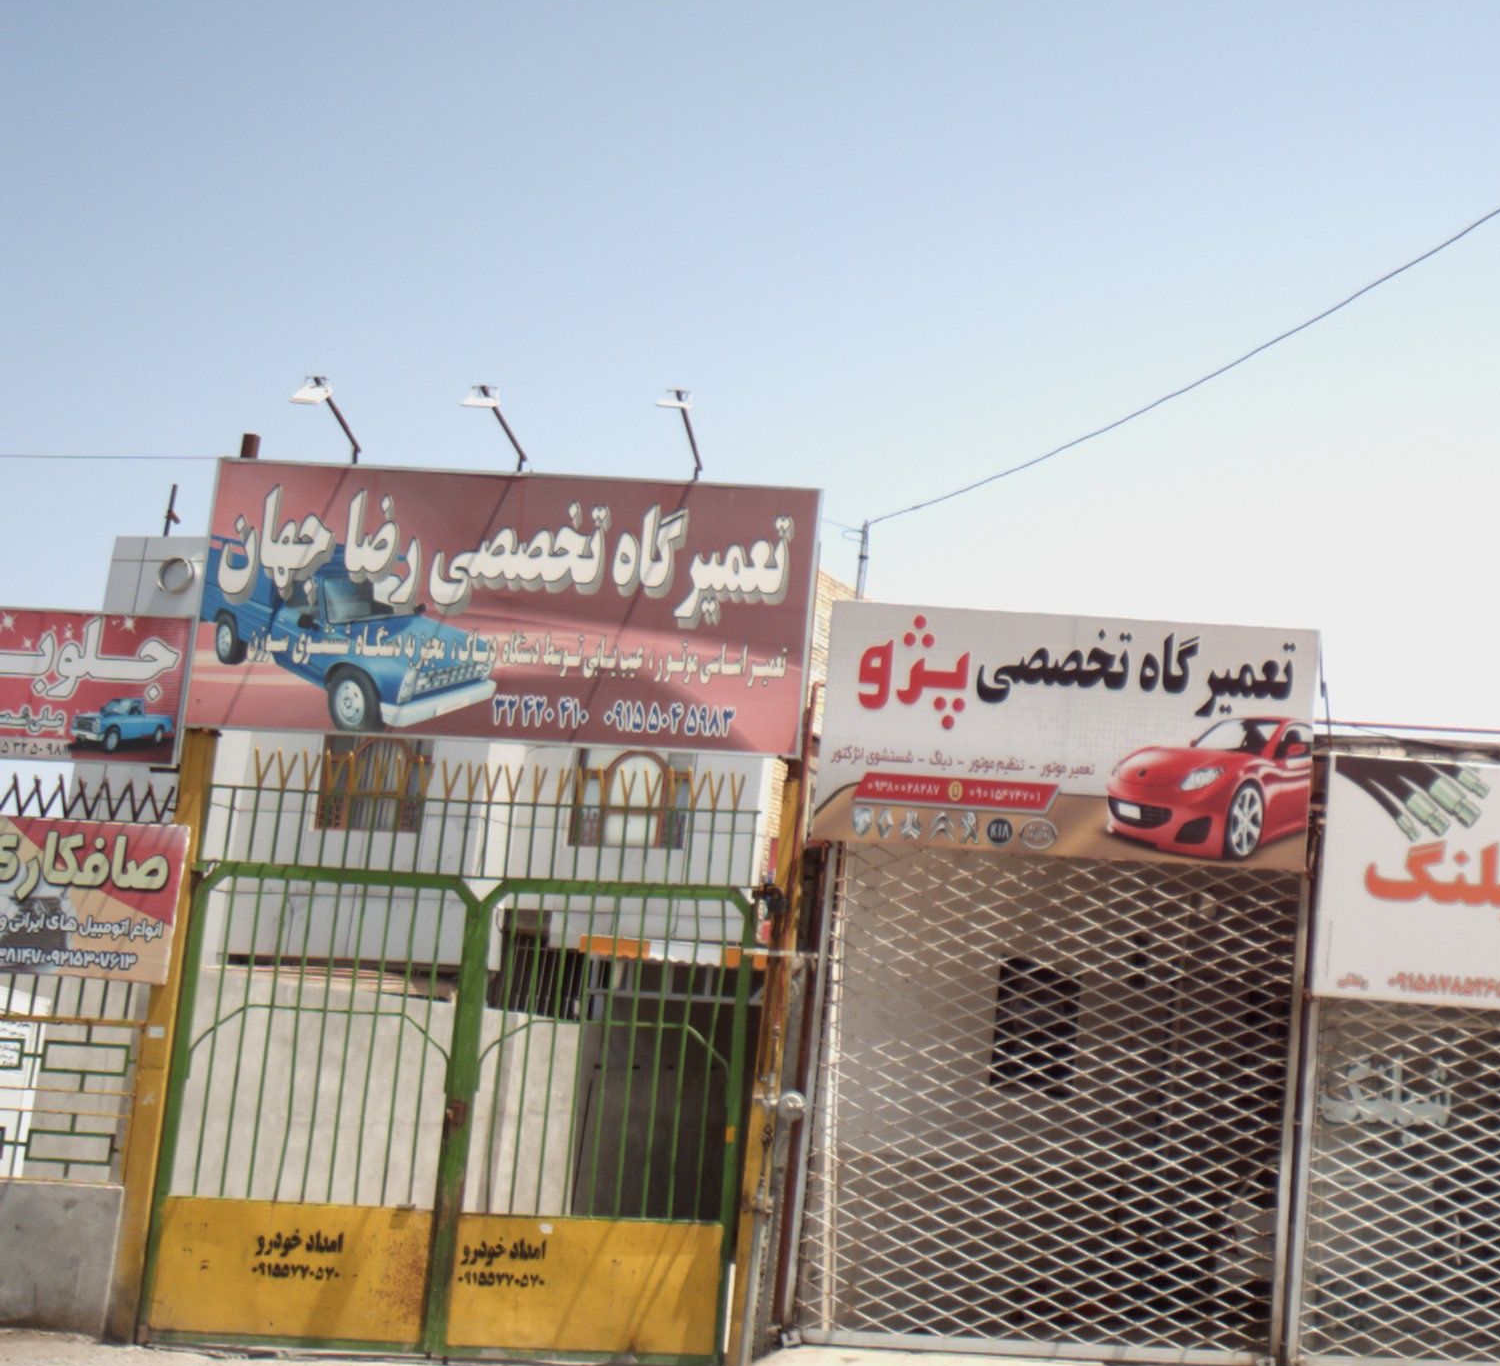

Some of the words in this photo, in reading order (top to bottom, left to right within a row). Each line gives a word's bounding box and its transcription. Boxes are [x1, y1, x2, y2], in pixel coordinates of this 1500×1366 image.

[217, 483, 336, 607] جهان
[346, 487, 422, 612] رضا
[430, 501, 611, 606] تخصصی
[612, 501, 691, 592] گاه
[674, 512, 795, 630] تعمیر
[355, 623, 403, 659] دستگاه
[405, 637, 416, 668] به
[417, 633, 446, 669] مجهز
[502, 630, 540, 666] دستگاه
[543, 631, 584, 677] توسط
[700, 643, 747, 685] اساسی
[747, 647, 787, 687] تعمیر
[858, 614, 971, 730] پژو
[976, 629, 1134, 703] تخصصی
[1140, 631, 1199, 694] گاه
[1196, 641, 1296, 716] تعمیر
[29, 705, 66, 733] علی
[830, 744, 865, 764] انژکتور
[866, 746, 914, 766] شستشوی
[929, 749, 953, 768] دیاگ
[967, 756, 995, 774] موتور
[996, 754, 1026, 776] تنظیم
[1039, 759, 1067, 778] موتور
[1068, 764, 1096, 780] تعمیر
[990, 823, 1010, 840] KIA
[8, 911, 45, 934] ایرانی
[46, 913, 78, 933] های
[79, 914, 132, 941] اتومبیل
[130, 917, 164, 942] انواع
[255, 1227, 303, 1257] خودرو
[305, 1230, 345, 1254] امداد
[460, 1236, 506, 1266] خودرو
[509, 1237, 548, 1261] امداد
